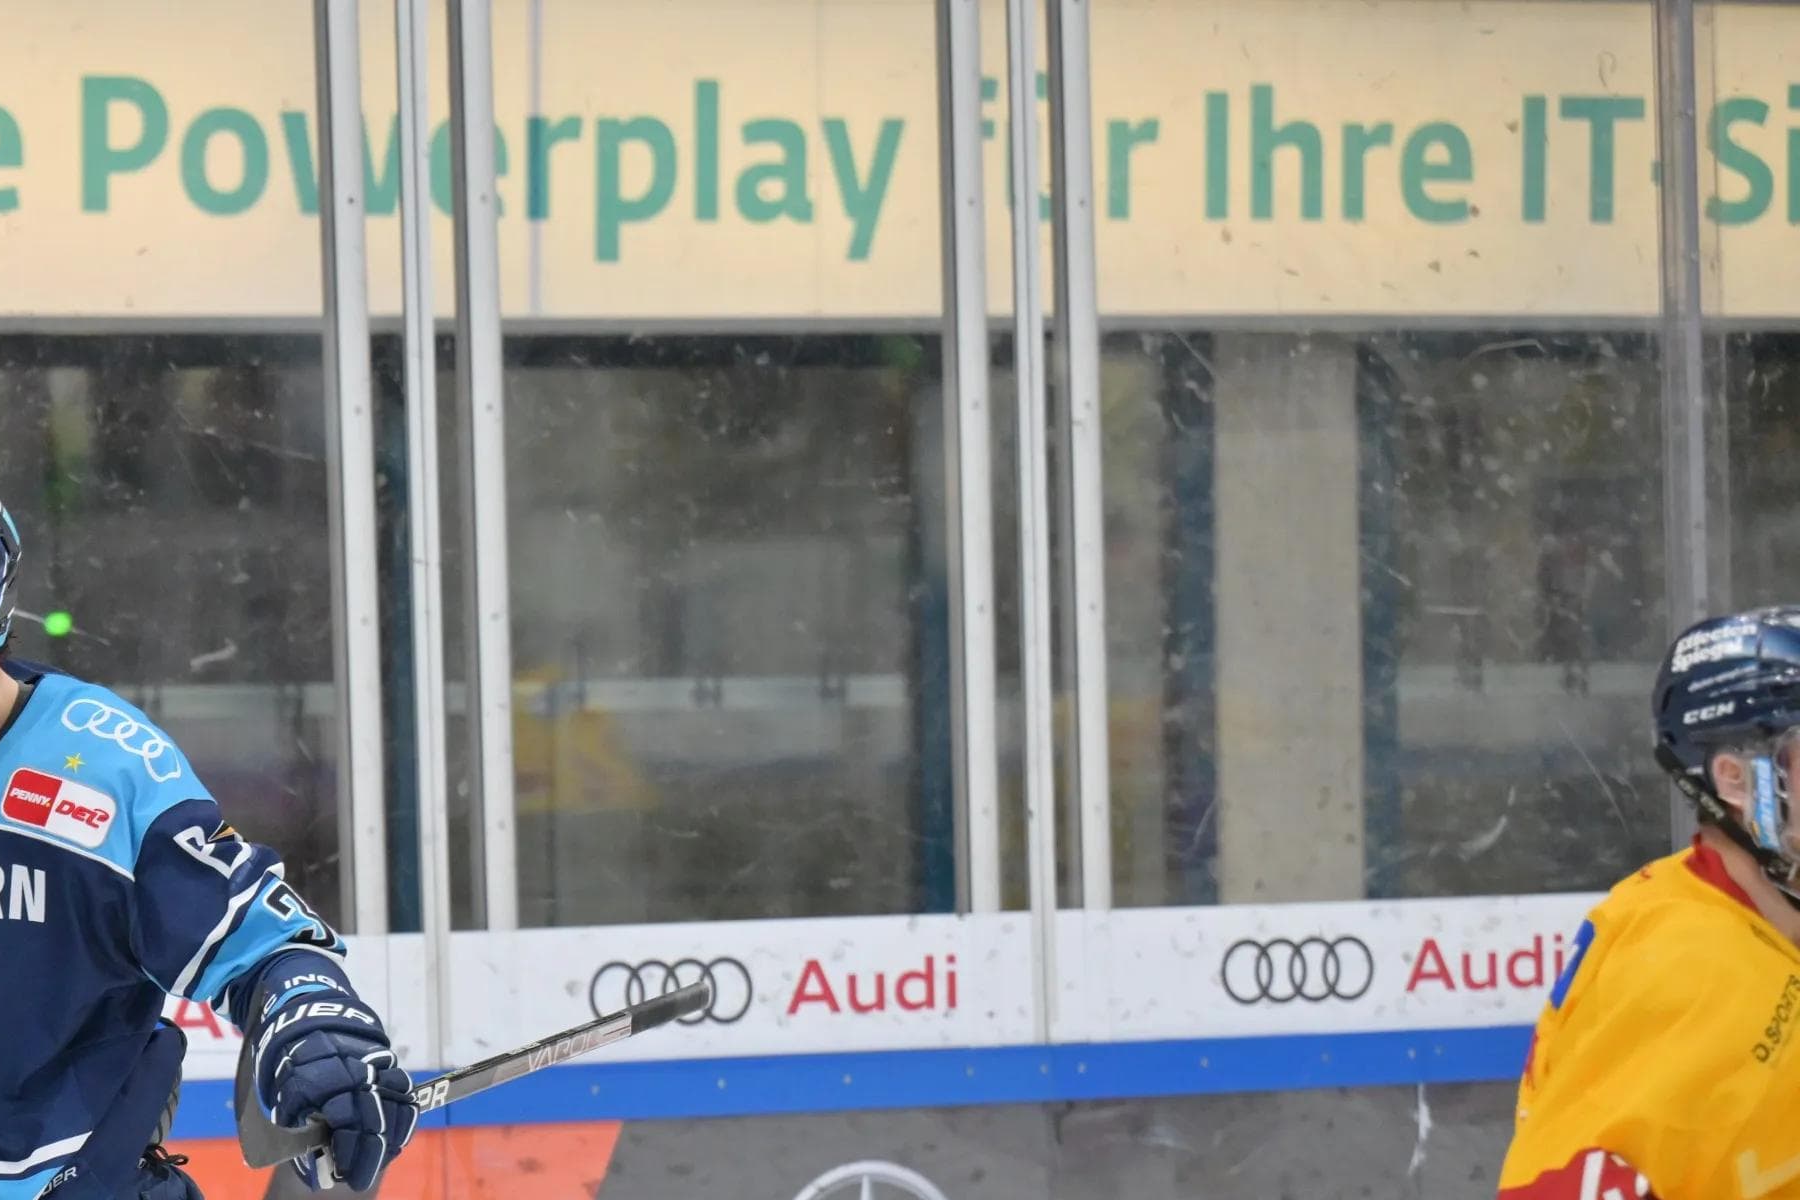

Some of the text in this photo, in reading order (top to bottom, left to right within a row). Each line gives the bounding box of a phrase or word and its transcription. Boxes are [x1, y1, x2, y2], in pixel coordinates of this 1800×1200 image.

[1204, 84, 1475, 221] Ihre
[788, 955, 957, 1016] Audi
[1406, 934, 1564, 992] Audi
